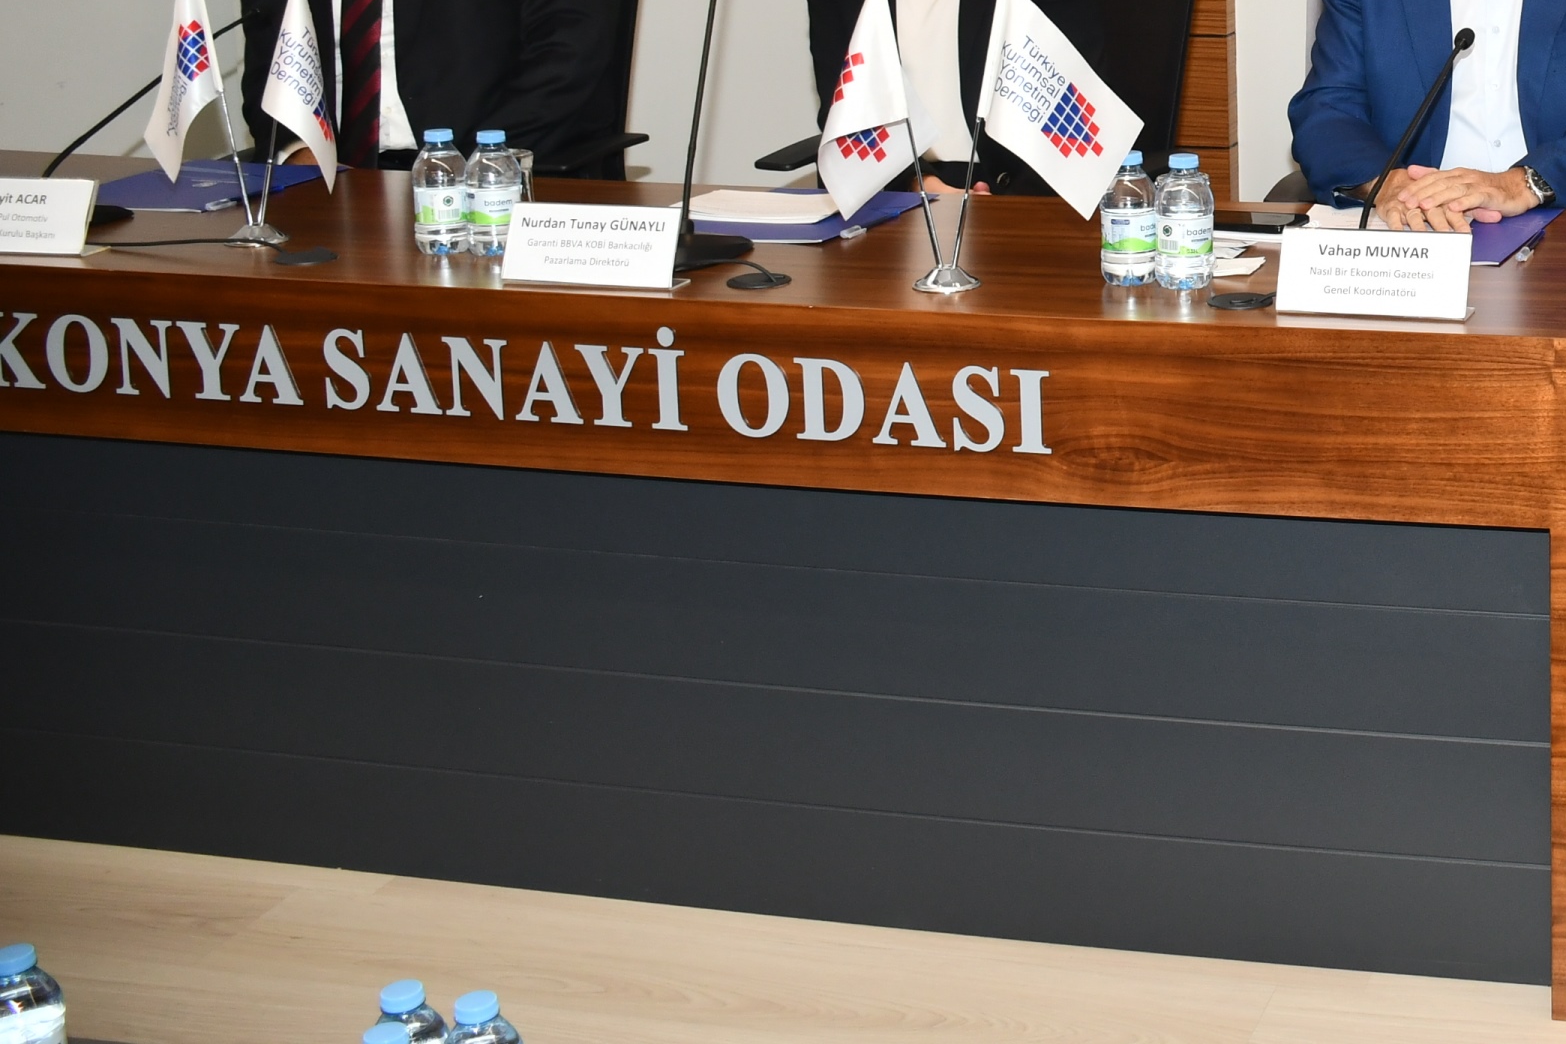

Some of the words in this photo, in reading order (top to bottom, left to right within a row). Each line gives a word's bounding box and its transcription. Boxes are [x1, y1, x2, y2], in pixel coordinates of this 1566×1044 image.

[1022, 35, 1066, 86] Türkiye
[278, 46, 321, 97] Yönetim
[1000, 40, 1061, 99] Kurumsal
[270, 61, 316, 107] Derneği
[999, 59, 1052, 111] Yönetim
[994, 77, 1046, 124] Derneği
[16, 193, 47, 205] ACAR
[484, 198, 513, 207] badem
[11, 213, 48, 223] Otomotiv
[521, 217, 566, 230] Nurdan
[570, 218, 606, 233] Tunay
[610, 216, 666, 232] GÜNAYLI
[26, 230, 56, 240] Başkanı
[527, 238, 559, 248] Garanti
[561, 239, 583, 249] BBVA
[585, 239, 606, 249] KOBİ
[609, 241, 653, 252] Bankacılığı
[1318, 244, 1361, 258] Vahap
[1365, 245, 1429, 259] MUNYAR
[544, 256, 587, 267] Pazarlama
[589, 256, 630, 267] Direktörü
[1310, 267, 1333, 277] Nasıl
[1334, 267, 1347, 277] Bir
[1350, 268, 1391, 278] Ekonomi
[1393, 269, 1434, 280] Gazetesi
[1323, 285, 1351, 295] Genel
[1353, 286, 1417, 297] Koordinatörü
[0, 312, 304, 406] KONYA
[322, 325, 689, 433] SANAYİ
[716, 353, 1053, 455] ODASI
